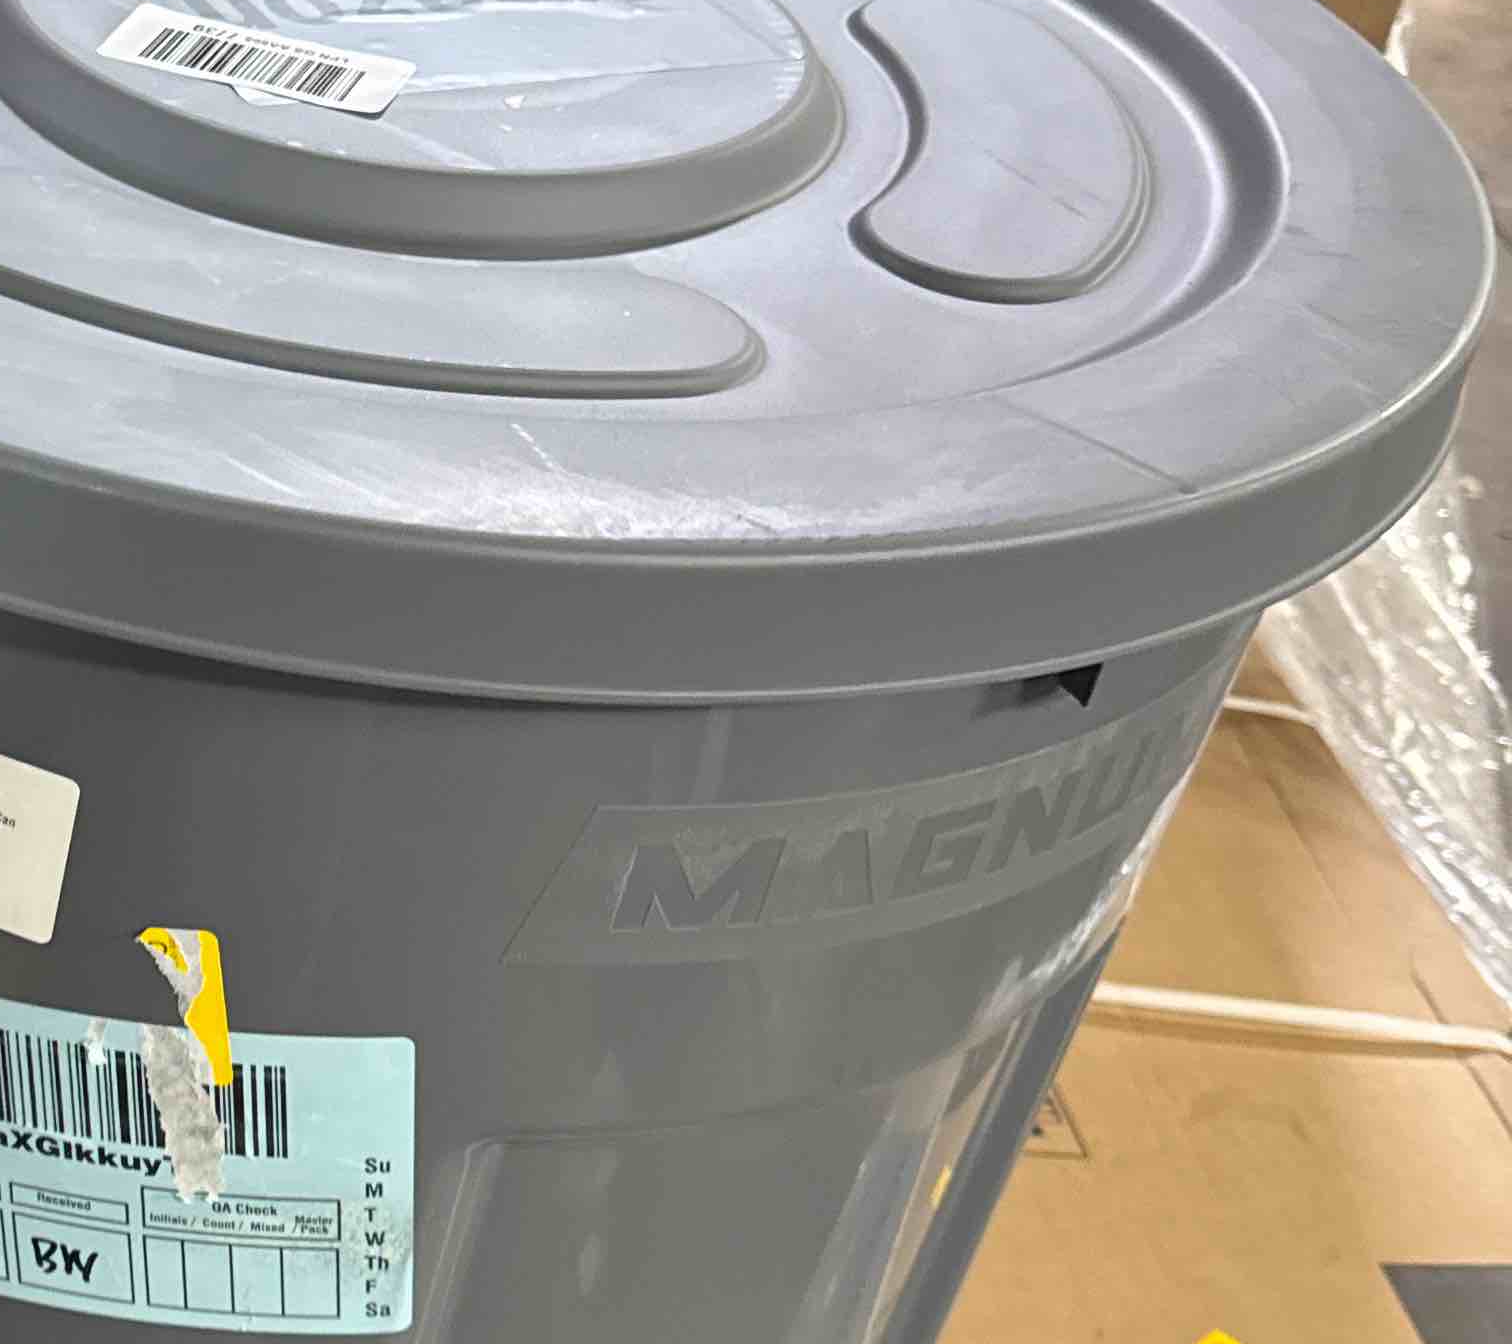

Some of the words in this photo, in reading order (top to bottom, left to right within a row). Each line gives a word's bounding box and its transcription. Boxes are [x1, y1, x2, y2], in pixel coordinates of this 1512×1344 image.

[364, 1157, 392, 1175] Su
[364, 1182, 384, 1198] M
[36, 1191, 92, 1212] Received
[235, 1201, 279, 1218] Check
[364, 1207, 377, 1223] T
[364, 1230, 387, 1247] W
[364, 1255, 390, 1273] Th
[364, 1279, 377, 1294] F
[364, 1302, 392, 1319] Sa
